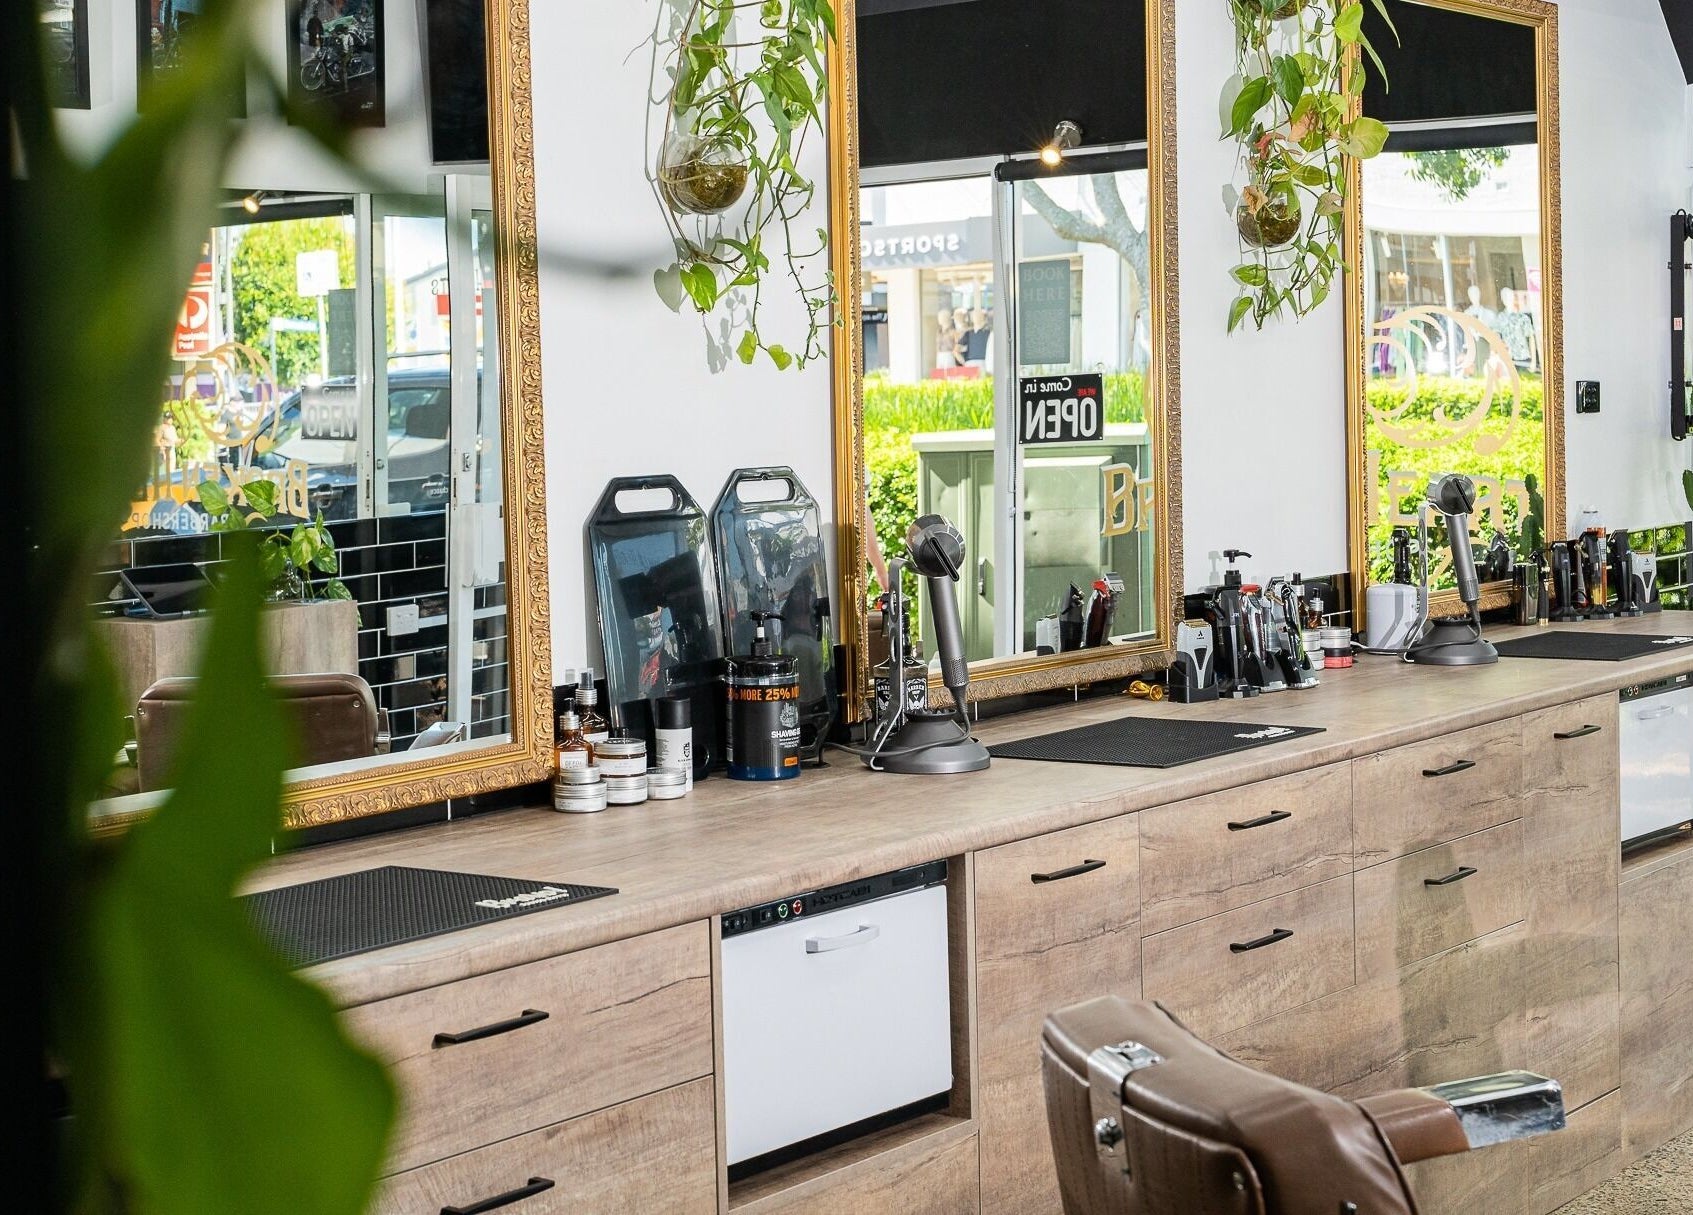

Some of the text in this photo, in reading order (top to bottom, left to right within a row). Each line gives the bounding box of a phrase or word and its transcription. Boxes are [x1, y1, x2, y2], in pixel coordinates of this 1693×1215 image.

[306, 404, 355, 438] OPEN
[740, 689, 762, 701] MORE
[765, 687, 791, 700] 25%
